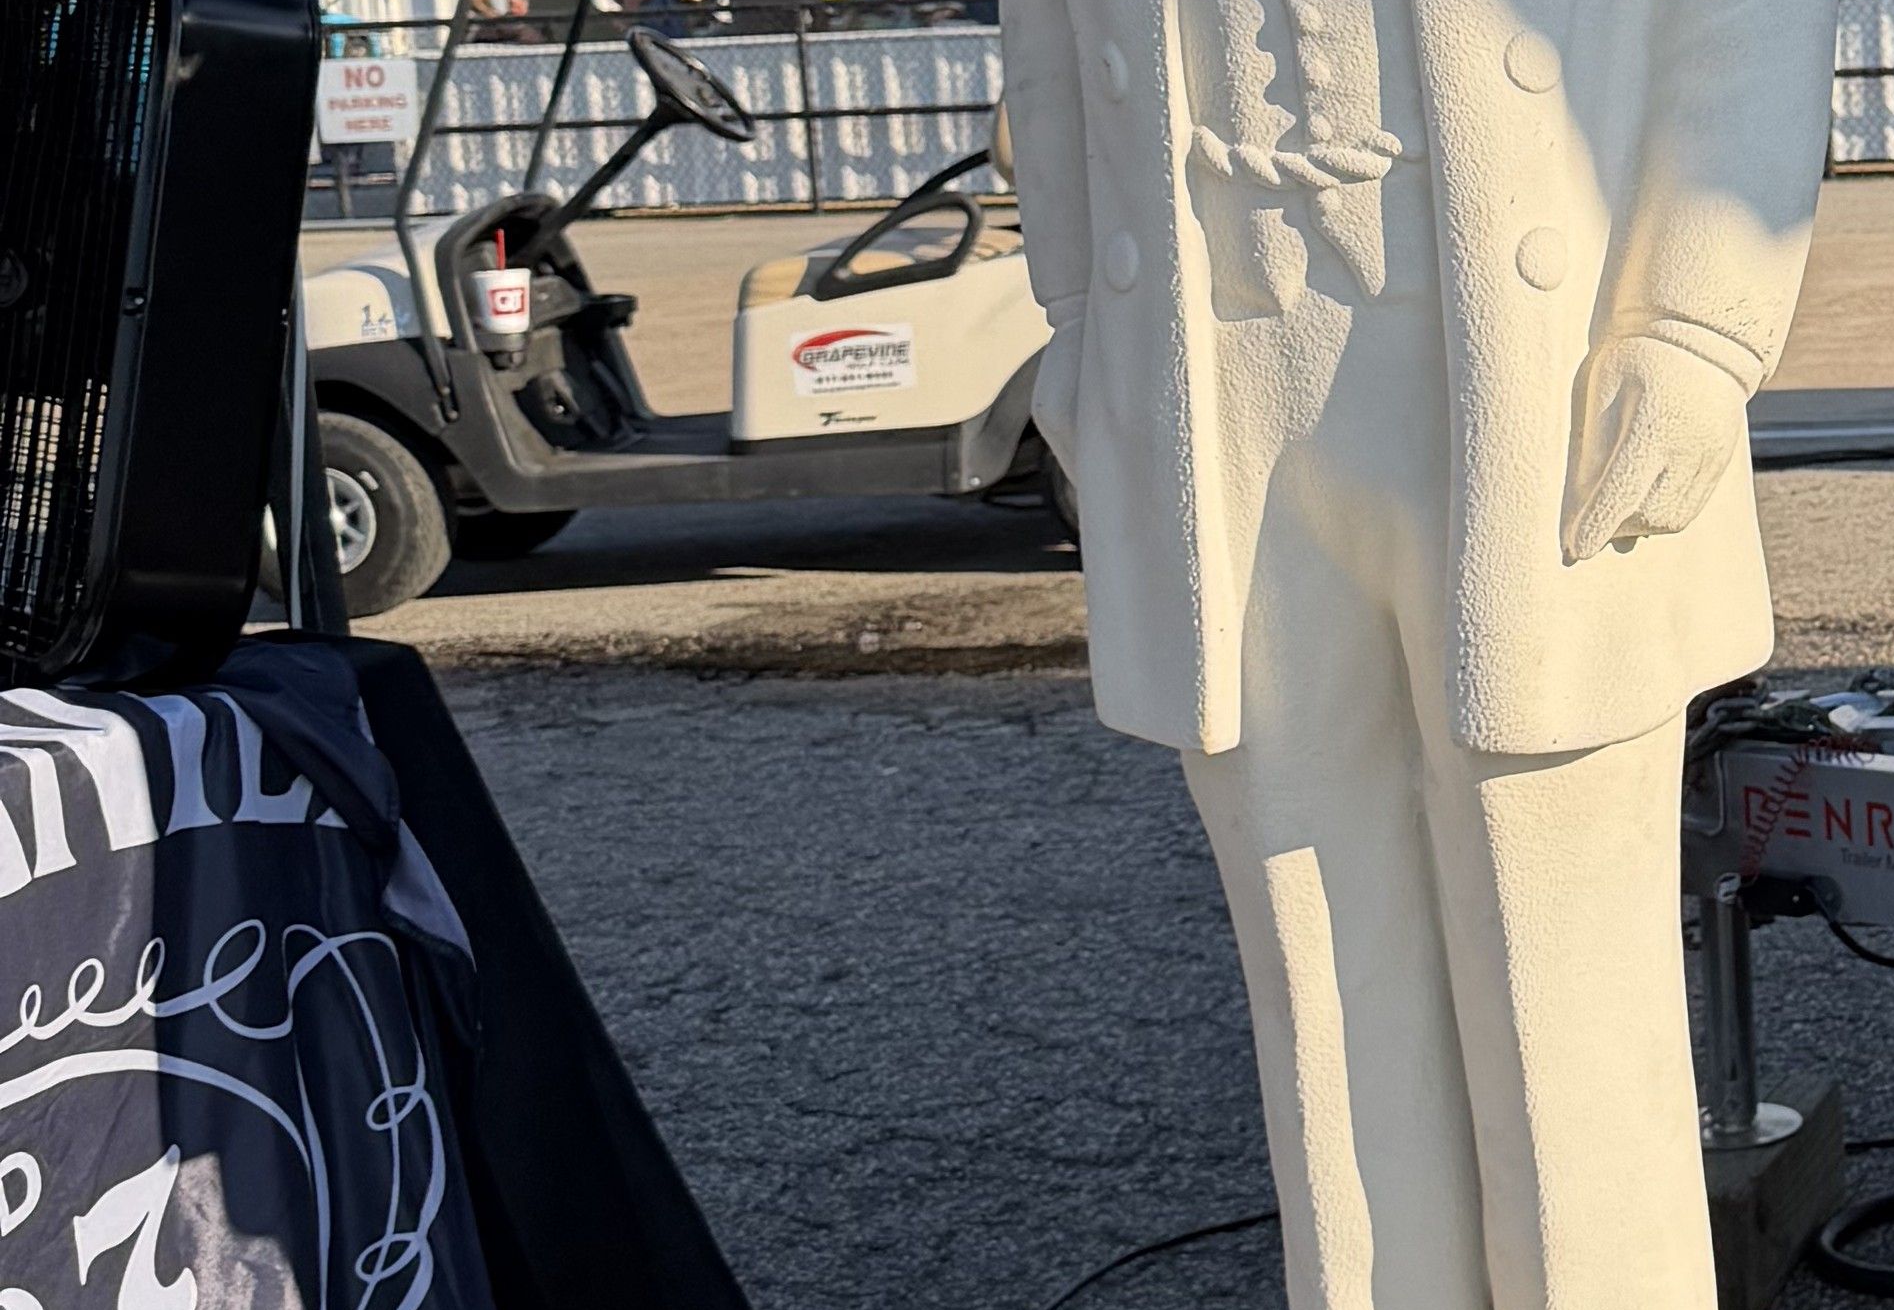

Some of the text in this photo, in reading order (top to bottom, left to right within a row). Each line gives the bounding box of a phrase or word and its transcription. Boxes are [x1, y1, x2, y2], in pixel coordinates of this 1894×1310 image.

[343, 65, 386, 88] NO
[327, 95, 408, 111] PARKING
[344, 117, 393, 132] HERE
[803, 340, 911, 365] GRAPEVINE
